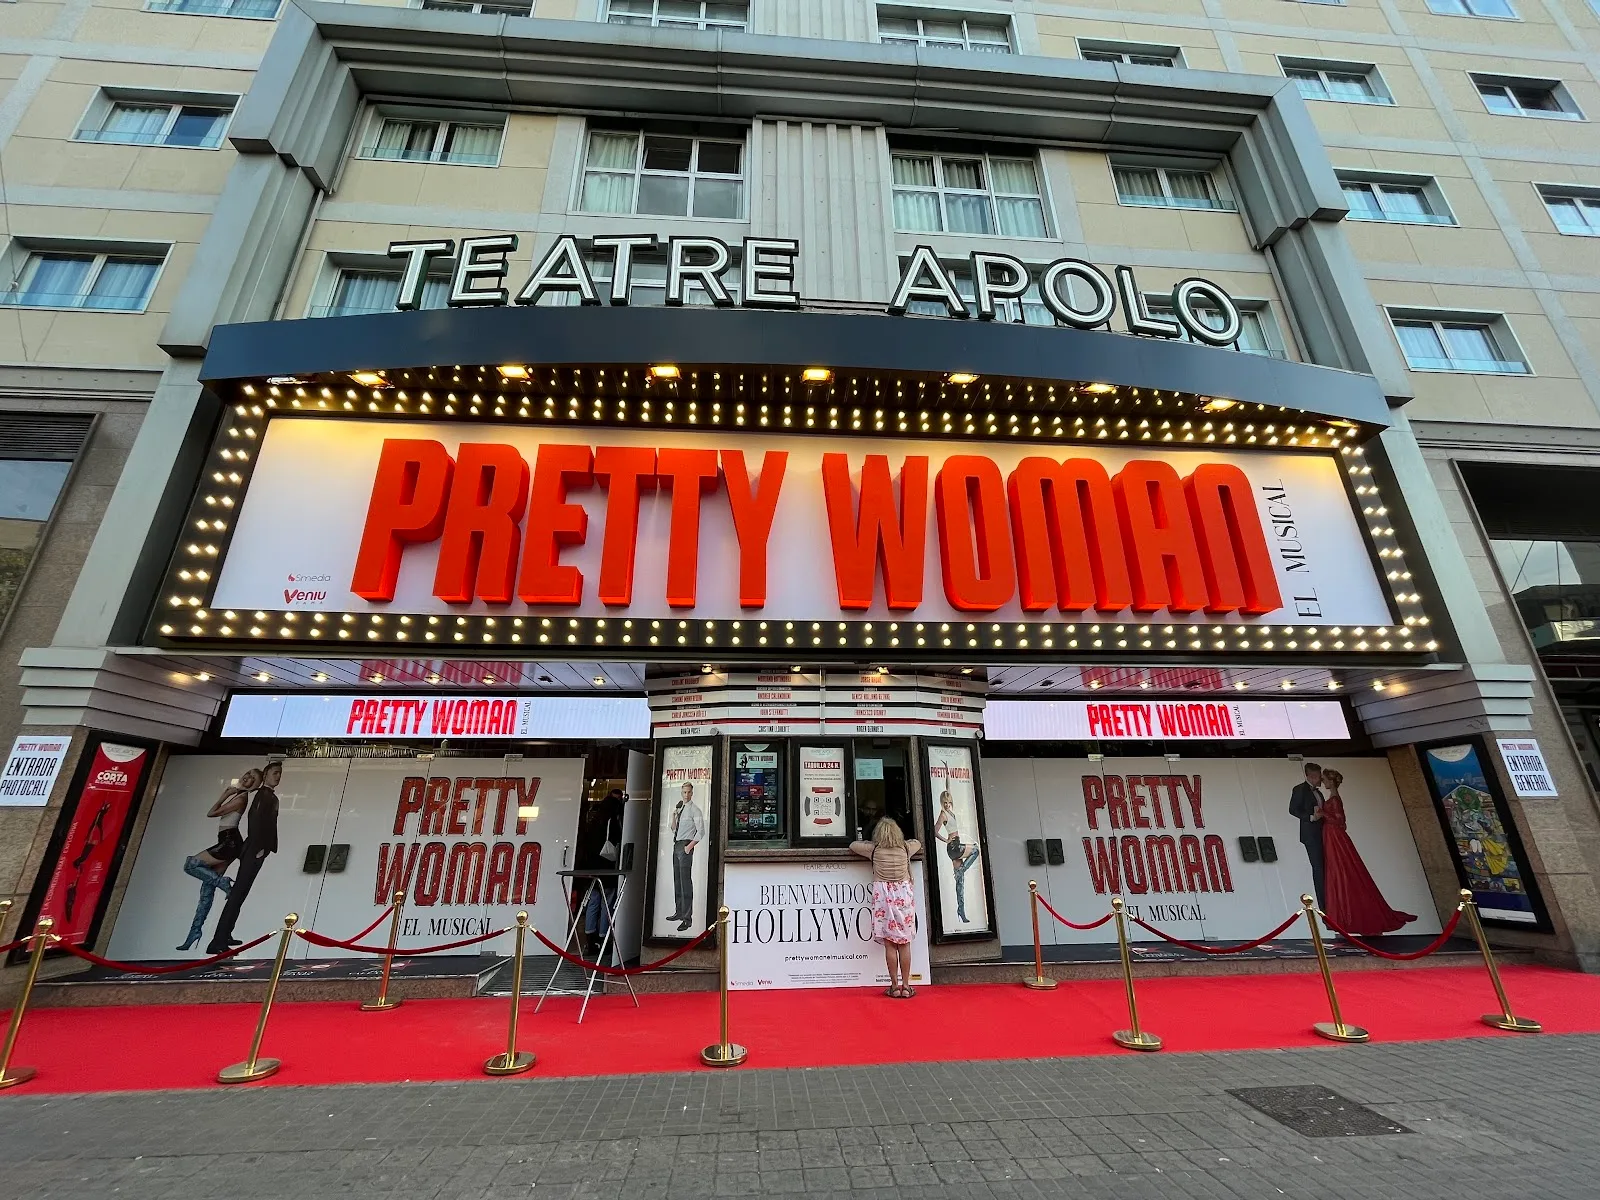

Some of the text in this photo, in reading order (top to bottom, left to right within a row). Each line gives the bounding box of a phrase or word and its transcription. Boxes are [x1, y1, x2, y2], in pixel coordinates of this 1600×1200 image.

[388, 234, 1244, 347] TEATRE APOLO
[351, 438, 1283, 615] PRETTY WOMAN
[1262, 478, 1322, 618] EL MUSICAL
[346, 699, 518, 735] PRETTY WOMAN
[1086, 704, 1235, 737] PRETTY WOMAN
[6, 757, 58, 777] ENTRADA
[97, 772, 128, 782] CORTA
[1506, 756, 1545, 772] ENTRADA
[0, 780, 49, 796] PHOTOCALL
[1514, 774, 1553, 792] GENERAL
[393, 777, 541, 836] PRETTY
[1081, 775, 1205, 830] PRETTY
[374, 842, 542, 906] WOMAN
[1082, 835, 1234, 895] WOMAN
[760, 883, 874, 906] BIENVENIDOS
[402, 918, 494, 936] EL MUSICAL
[732, 907, 918, 944] HOLLYWO
[1149, 905, 1206, 921] MUSICAL
